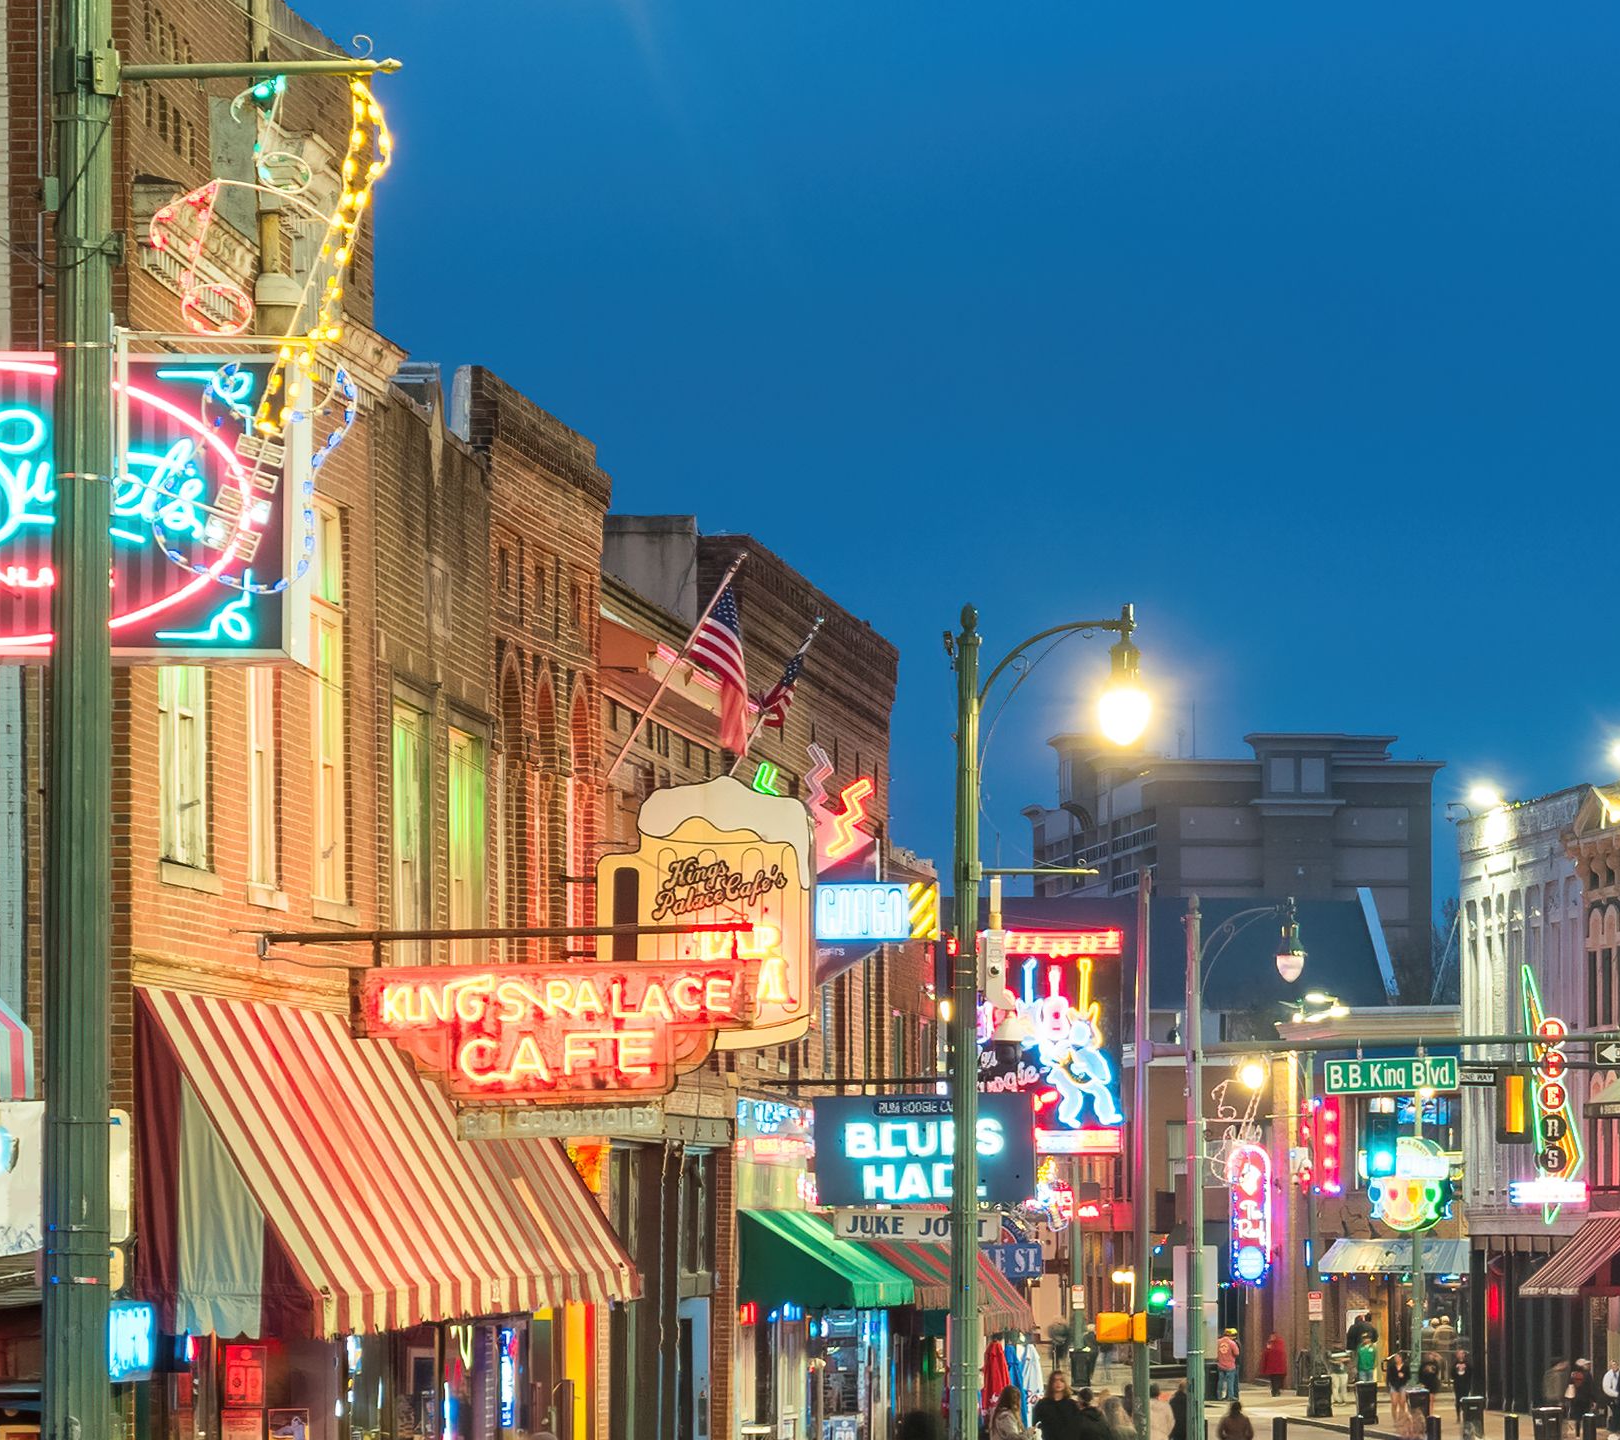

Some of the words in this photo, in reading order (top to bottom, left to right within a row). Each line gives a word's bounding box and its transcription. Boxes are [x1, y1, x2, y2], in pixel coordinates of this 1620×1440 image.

[663, 857, 729, 891] Kings
[652, 887, 725, 921] Palace
[820, 887, 903, 935] CARGO
[818, 947, 846, 956] GIFTS
[545, 978, 734, 1021] PALACE
[461, 1031, 655, 1083] CAFE
[1330, 1064, 1368, 1089] B.B.
[1370, 1062, 1406, 1089] King
[1412, 1060, 1455, 1086] Blvd.
[1477, 1073, 1494, 1082] WAY
[878, 1101, 901, 1114] RUM
[902, 1100, 938, 1114] BOOGIE
[845, 1216, 905, 1235] JUKE
